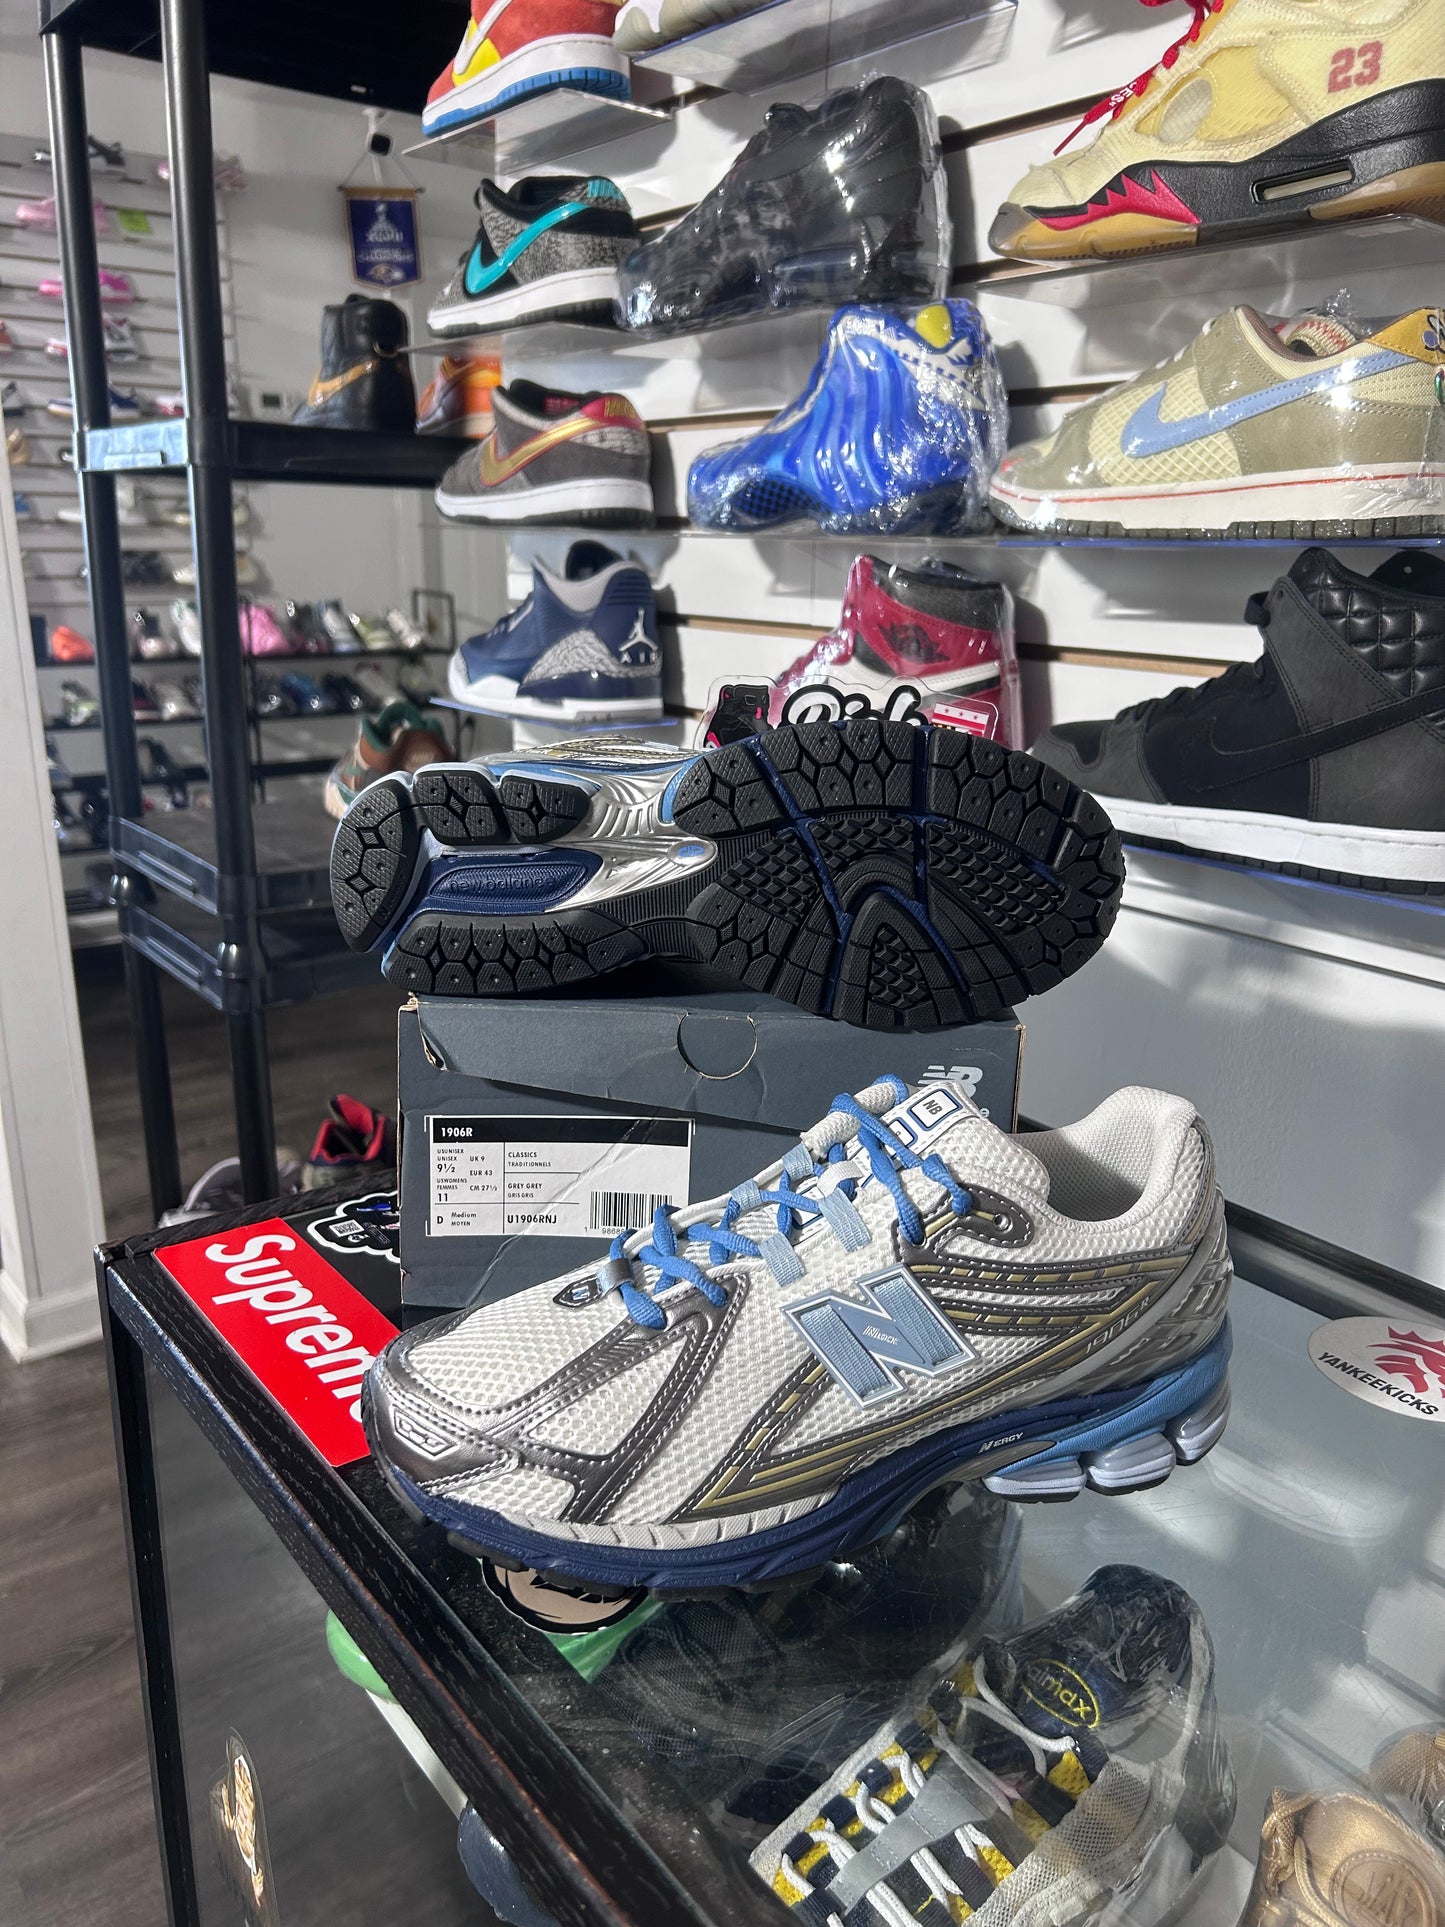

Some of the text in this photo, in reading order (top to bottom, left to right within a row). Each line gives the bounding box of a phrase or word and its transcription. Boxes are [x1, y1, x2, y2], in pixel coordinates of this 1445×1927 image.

[1328, 40, 1383, 93] 23
[922, 1099, 943, 1115] NB
[440, 1127, 473, 1137] 1906R
[438, 1193, 448, 1202] 11
[437, 1215, 444, 1224] D
[507, 1214, 557, 1224] U1906RNJ
[205, 1234, 374, 1424] Suprem
[1318, 1352, 1439, 1415] YANKEEKICKS
